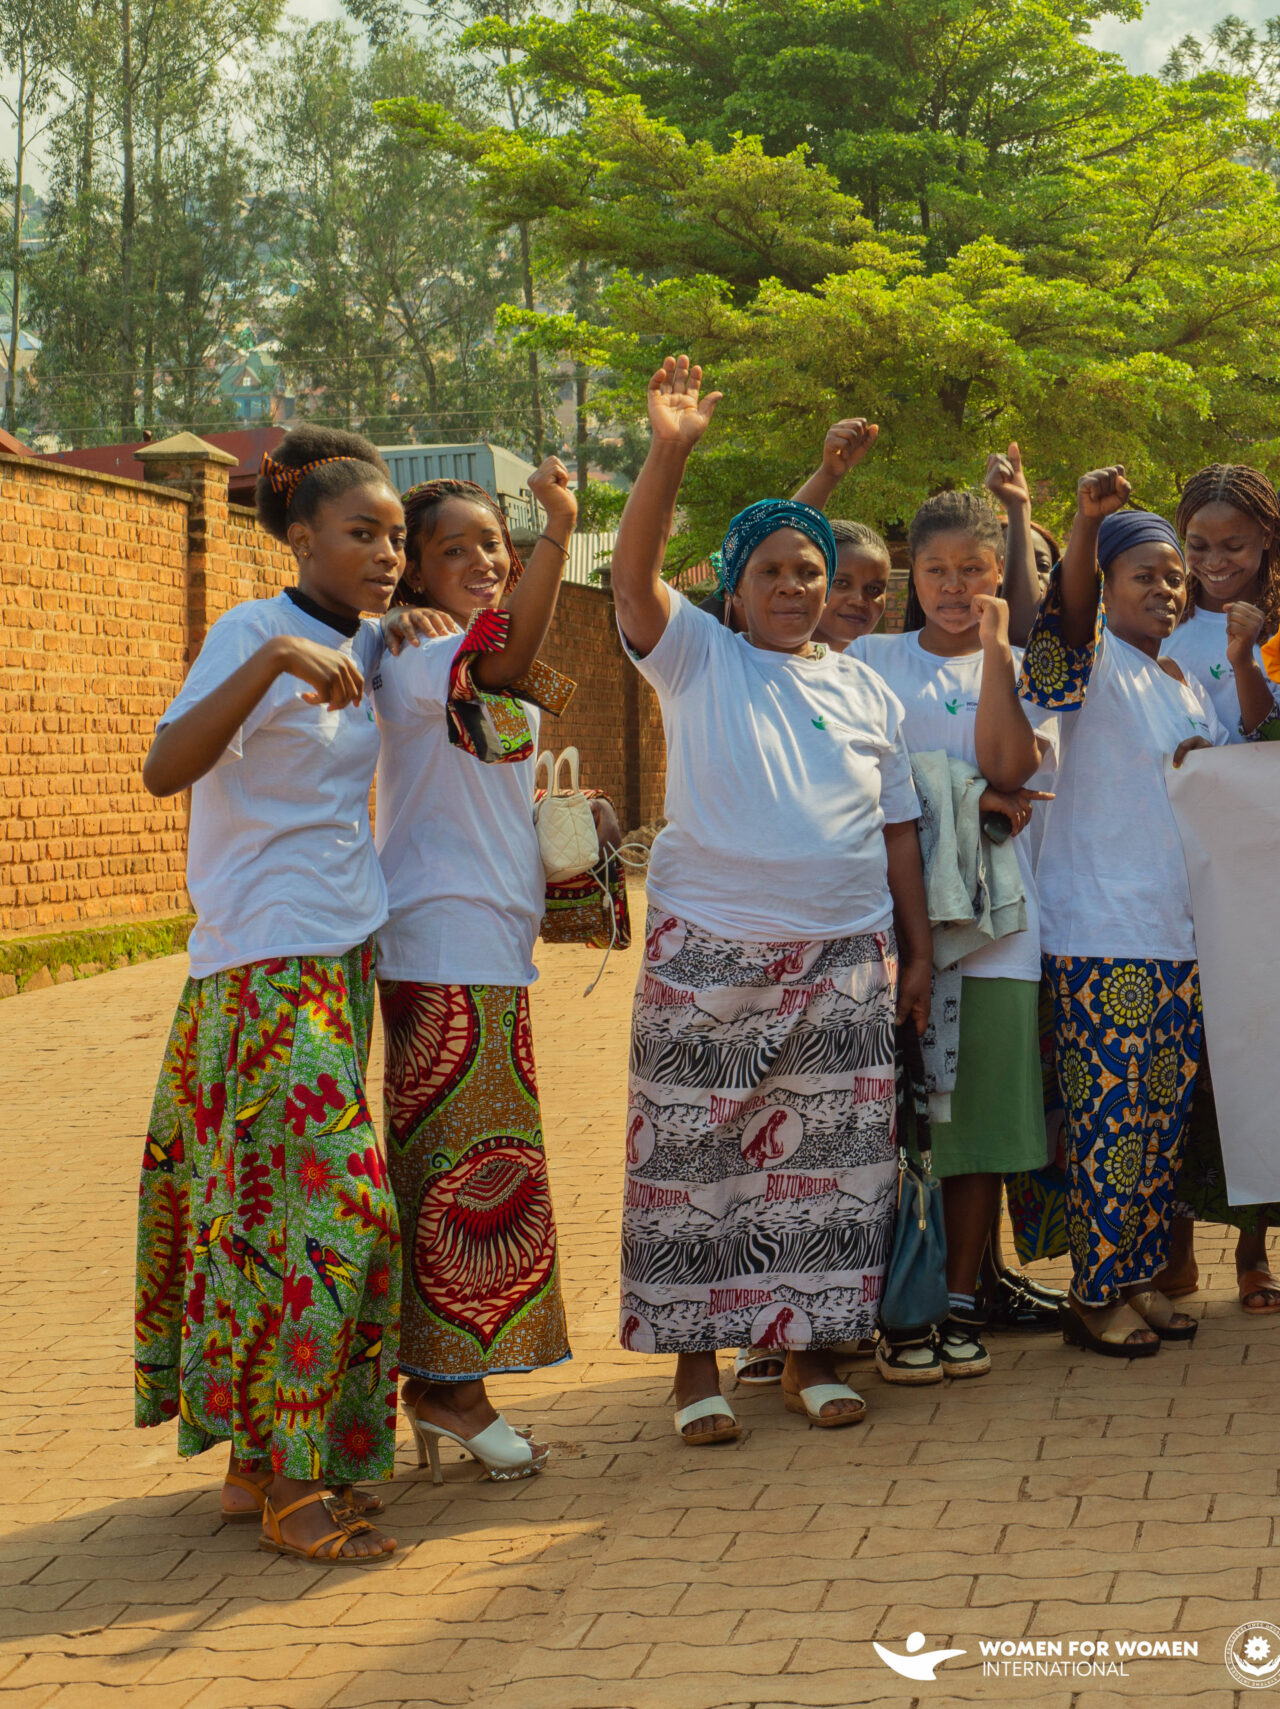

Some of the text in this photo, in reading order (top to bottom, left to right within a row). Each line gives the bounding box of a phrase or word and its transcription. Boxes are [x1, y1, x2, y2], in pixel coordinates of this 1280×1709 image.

[626, 1177, 690, 1208] BUJUMBURA
[765, 1173, 839, 1202] BUJUMBURA
[709, 1288, 773, 1316] BUJUMBURA
